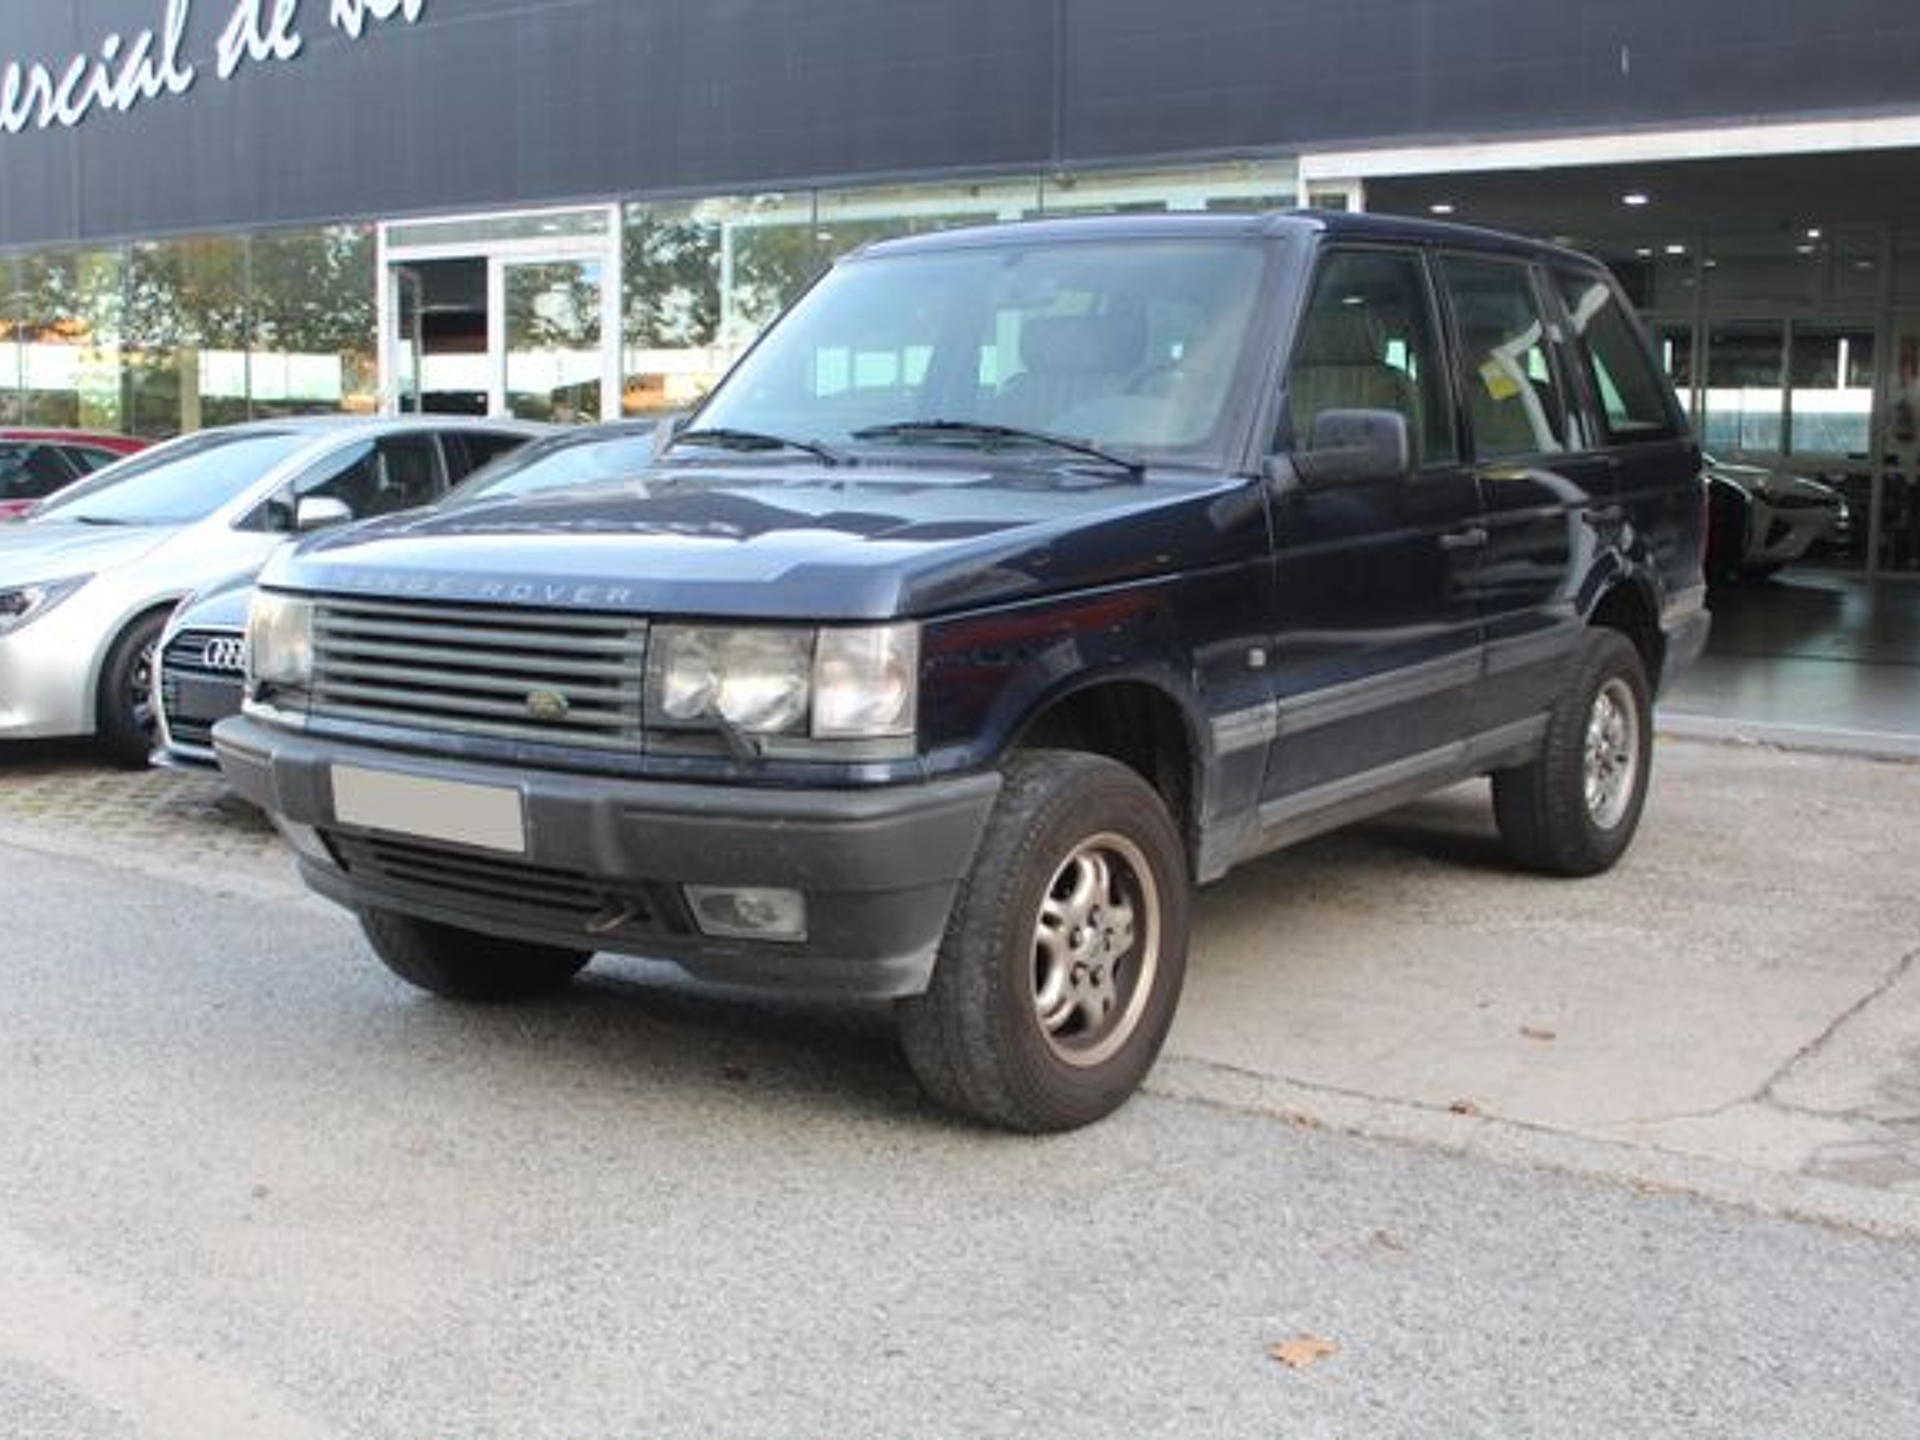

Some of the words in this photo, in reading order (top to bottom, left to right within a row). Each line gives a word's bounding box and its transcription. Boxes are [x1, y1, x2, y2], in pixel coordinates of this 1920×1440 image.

[0, 0, 194, 133] ercial
[216, 0, 301, 79] de
[478, 580, 633, 605] ROVER
